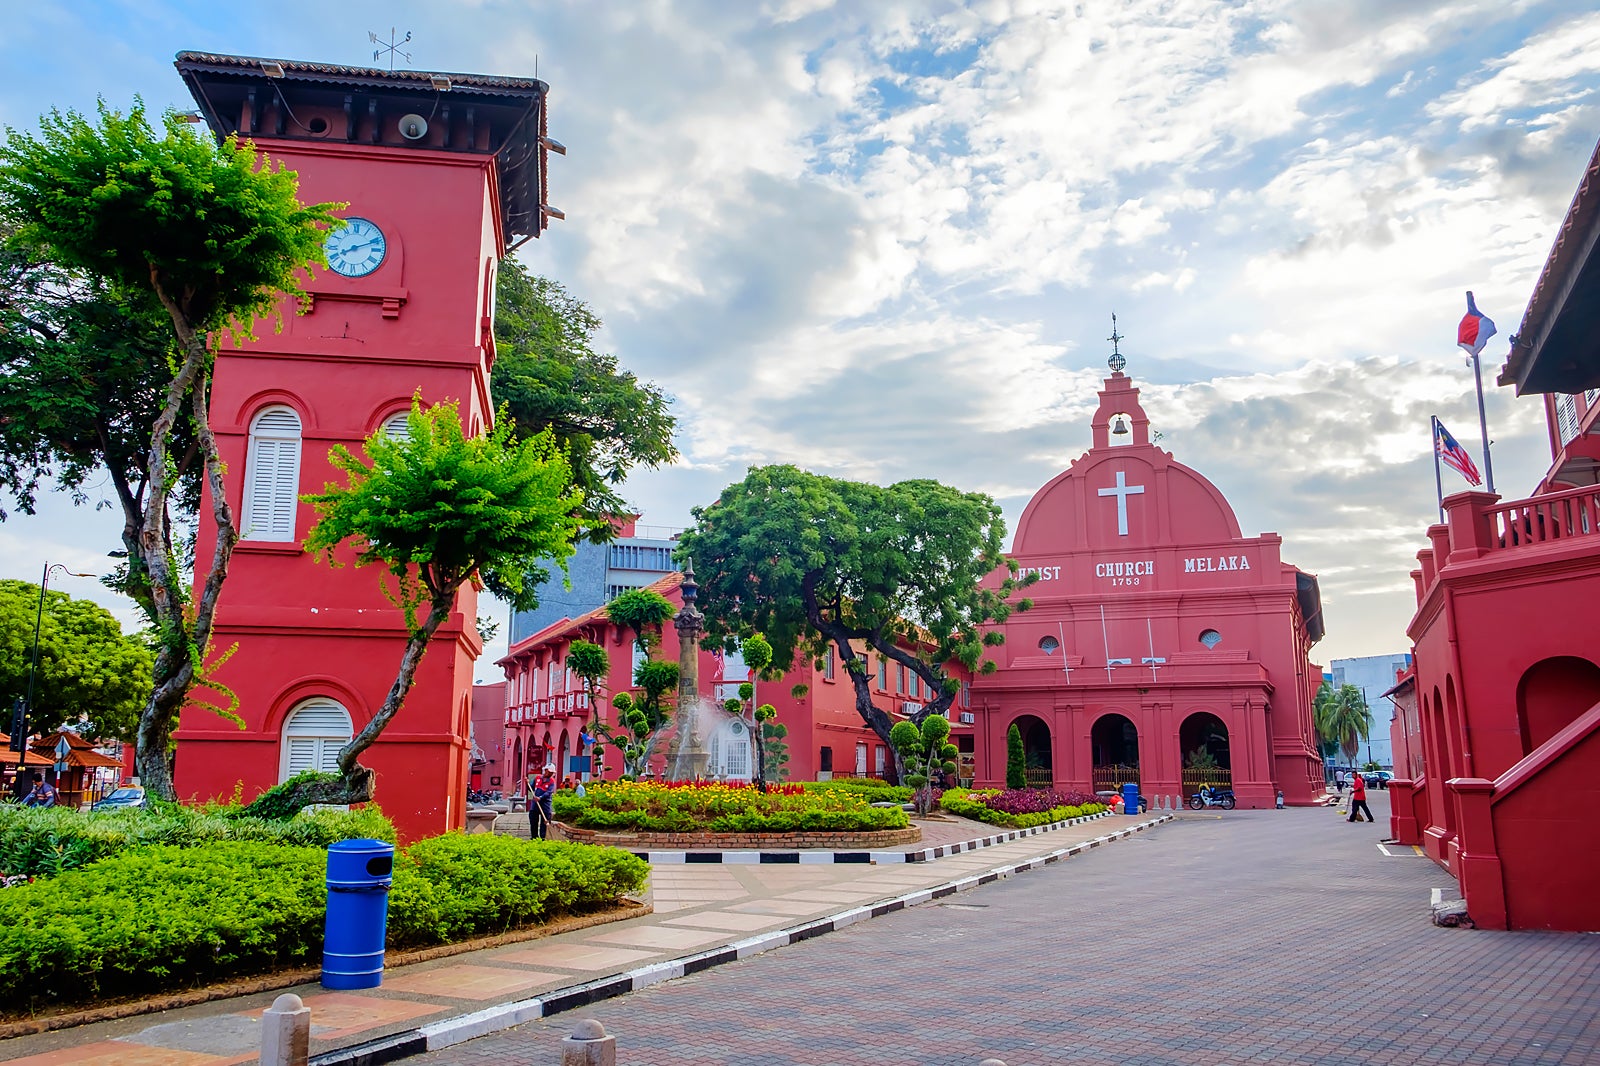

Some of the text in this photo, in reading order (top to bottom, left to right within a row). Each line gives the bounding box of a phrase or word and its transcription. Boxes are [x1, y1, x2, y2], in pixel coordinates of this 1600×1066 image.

[1095, 560, 1154, 577] CHURCH
[1184, 555, 1251, 573] MELAKA
[1112, 577, 1140, 586] 1753
